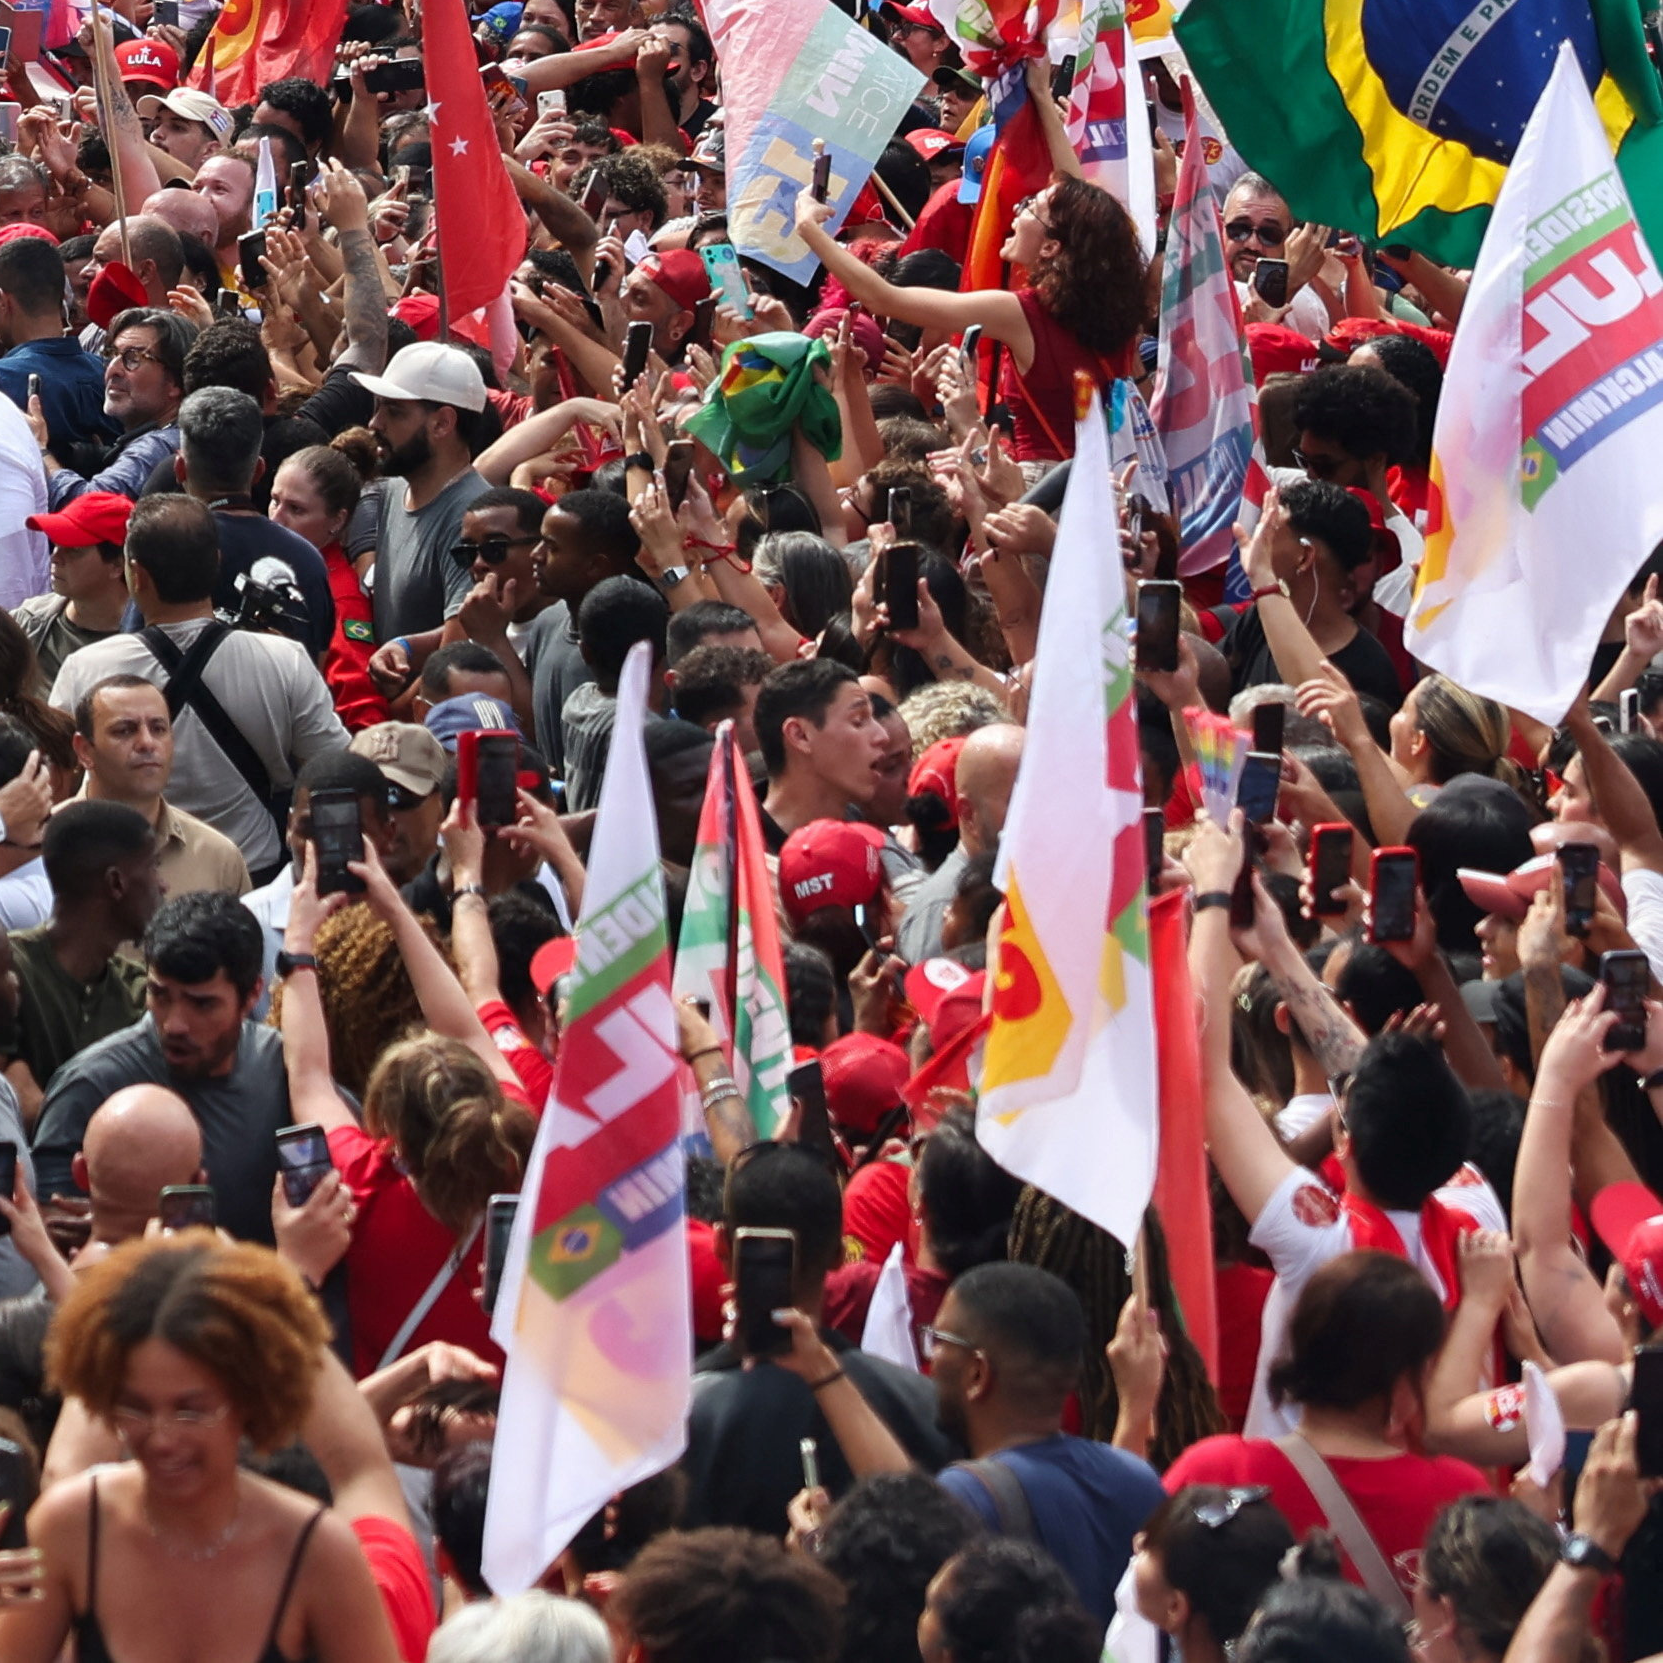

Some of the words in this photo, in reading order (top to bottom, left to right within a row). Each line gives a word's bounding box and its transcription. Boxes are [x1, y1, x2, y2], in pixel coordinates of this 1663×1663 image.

[126, 54, 159, 67] LULA
[1411, 44, 1458, 128] ORDEM
[1460, 23, 1477, 45] E
[796, 872, 836, 901] MST
